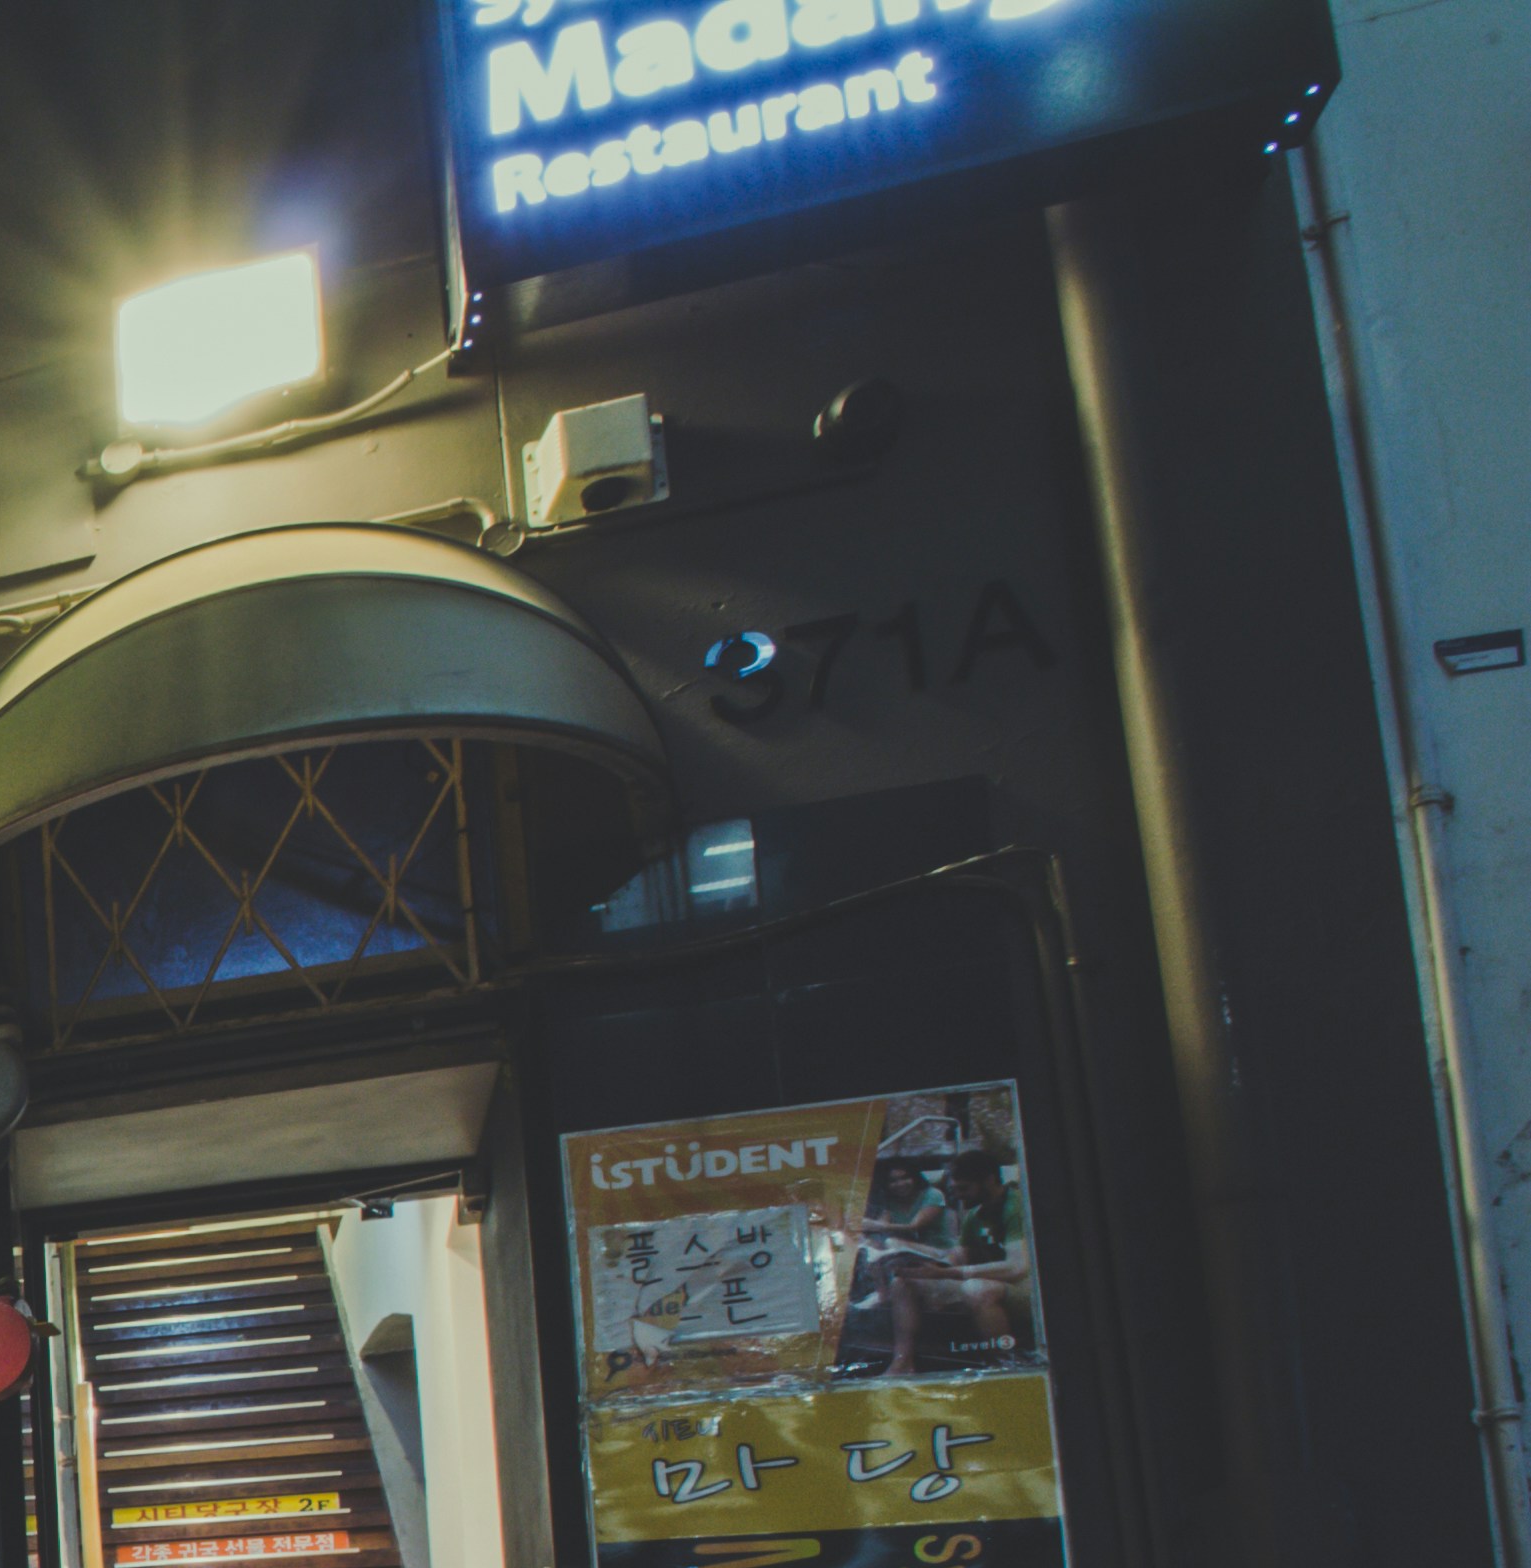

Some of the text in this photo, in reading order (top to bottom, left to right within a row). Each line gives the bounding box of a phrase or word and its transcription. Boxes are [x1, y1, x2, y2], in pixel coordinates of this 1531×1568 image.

[486, 0, 1068, 136] Mada
[493, 50, 937, 213] Restaurant
[299, 1498, 331, 1512] 2F
